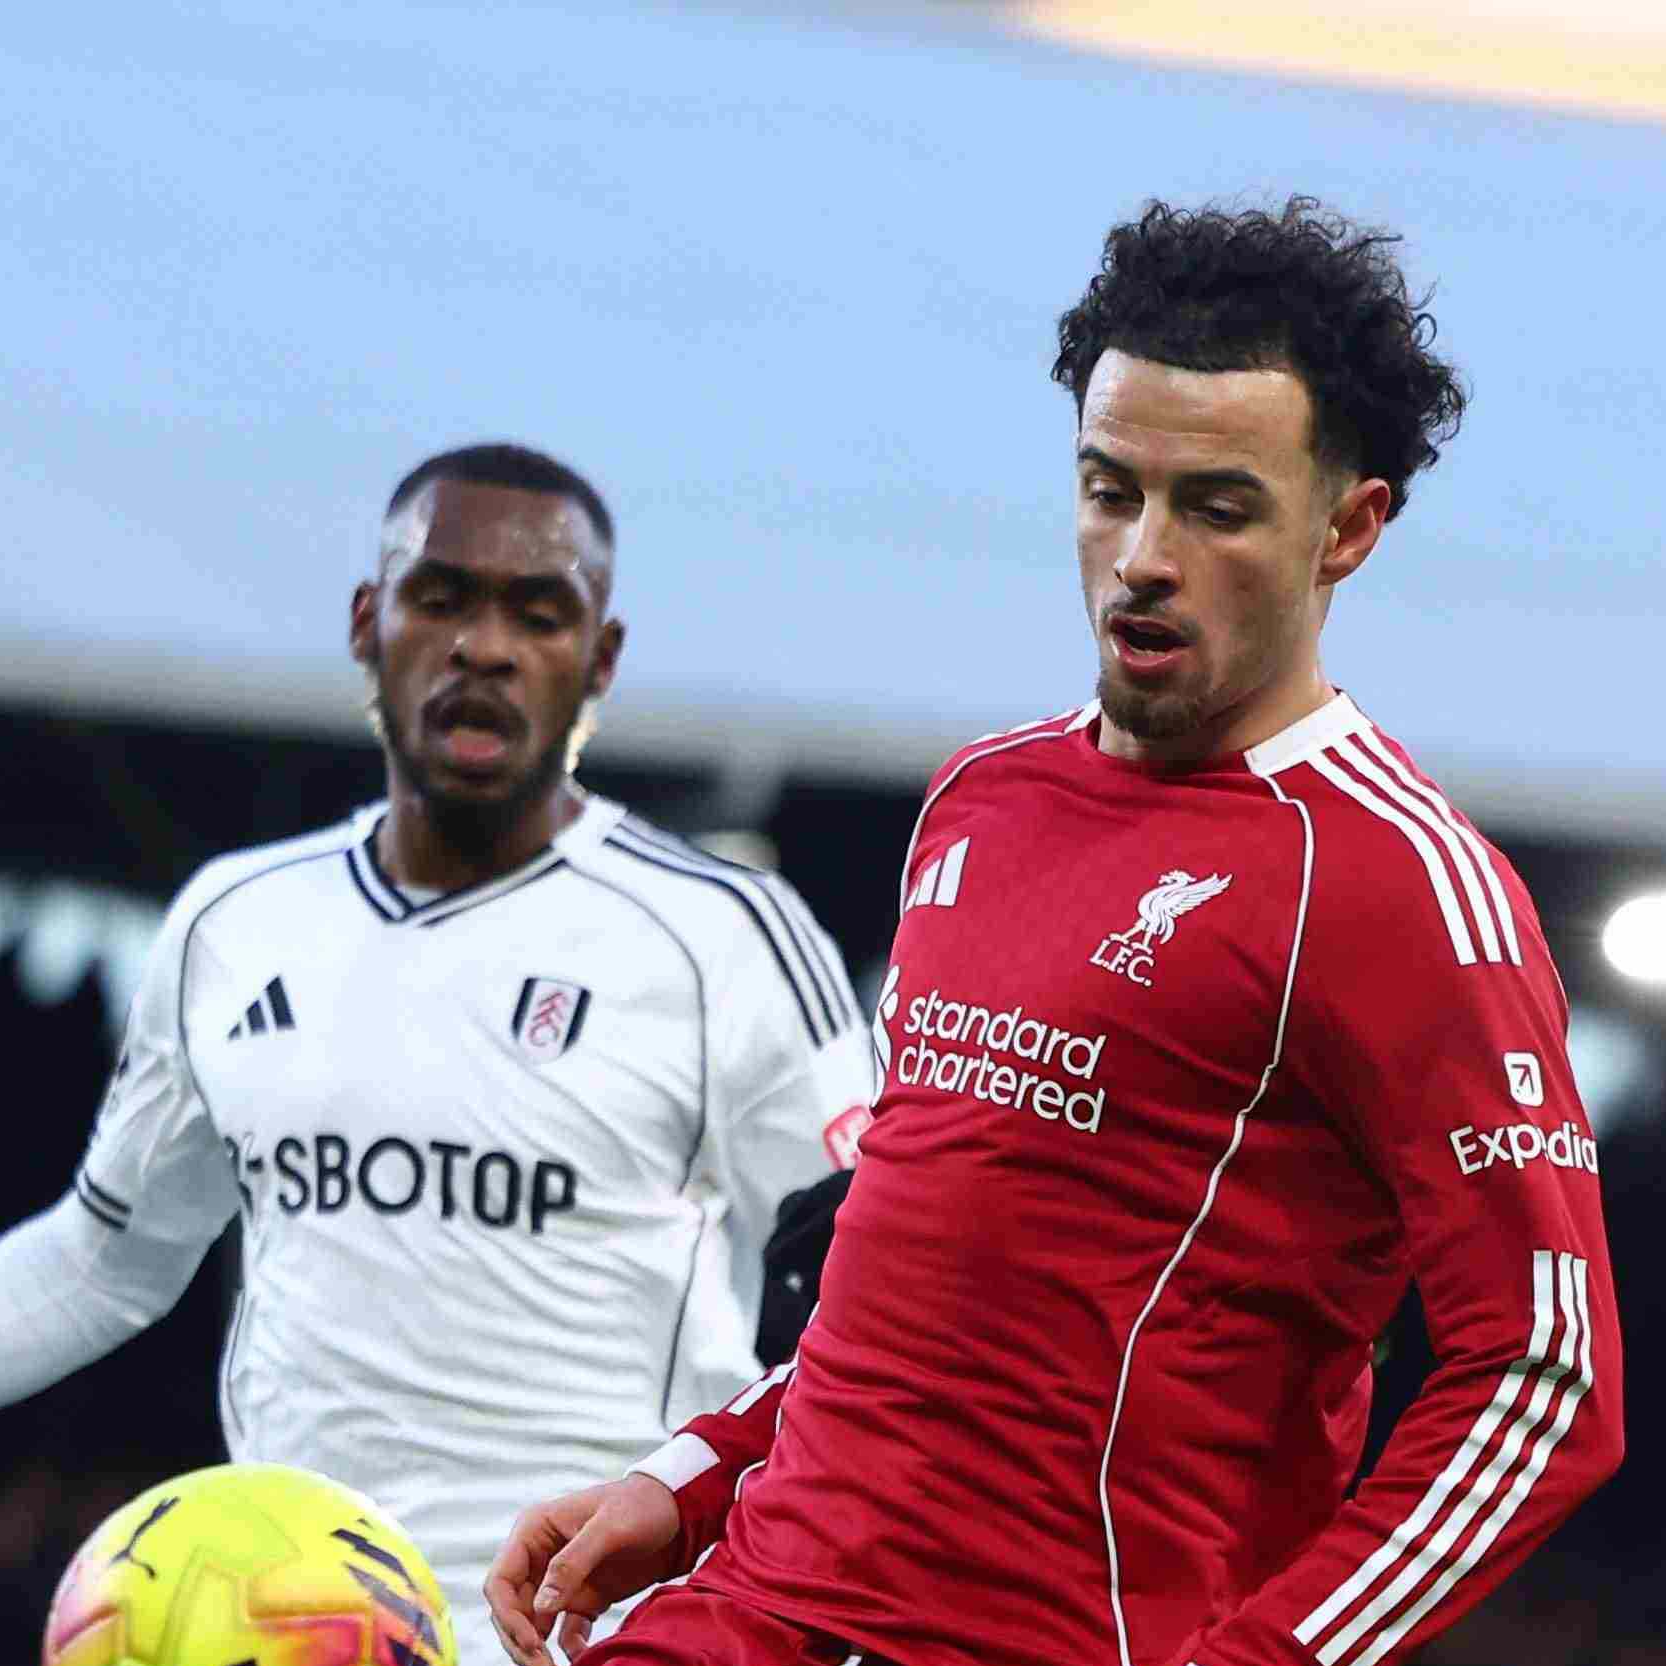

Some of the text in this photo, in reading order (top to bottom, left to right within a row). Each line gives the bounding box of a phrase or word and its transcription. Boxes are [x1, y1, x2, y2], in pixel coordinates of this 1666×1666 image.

[1089, 939, 1155, 987] L.F.C.
[904, 989, 1107, 1079] standard
[897, 1037, 1106, 1134] chartered
[274, 1134, 576, 1234] SBOTOP
